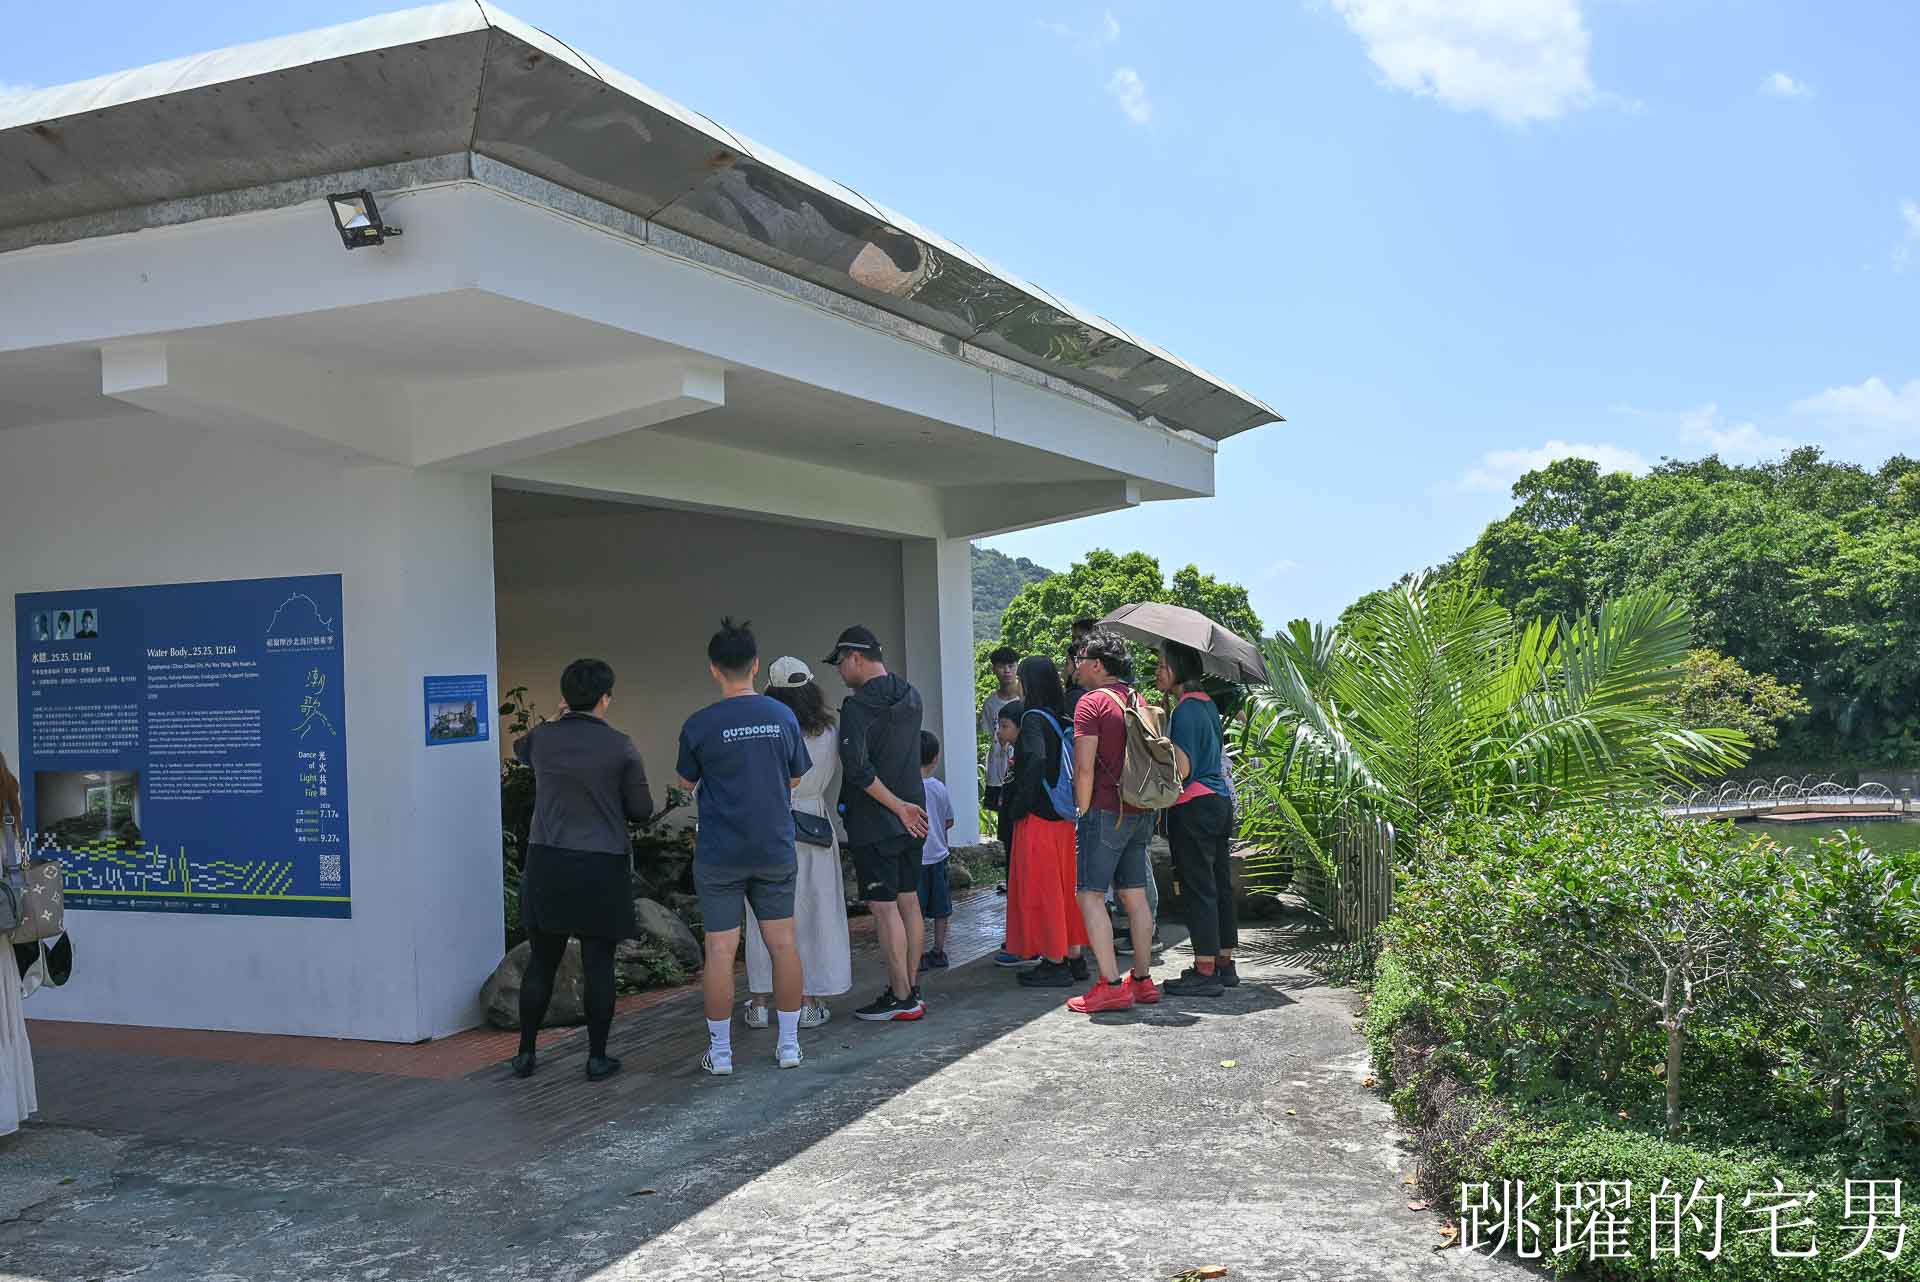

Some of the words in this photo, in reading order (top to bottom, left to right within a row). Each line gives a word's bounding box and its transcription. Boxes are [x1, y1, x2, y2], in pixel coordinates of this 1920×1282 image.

[147, 648, 168, 657] Water
[216, 645, 236, 655] 121.61
[723, 725, 780, 738] OUTDOORS
[298, 751, 317, 759] Dance
[308, 761, 315, 769] of
[299, 773, 317, 784] Light
[304, 788, 318, 797] Fire
